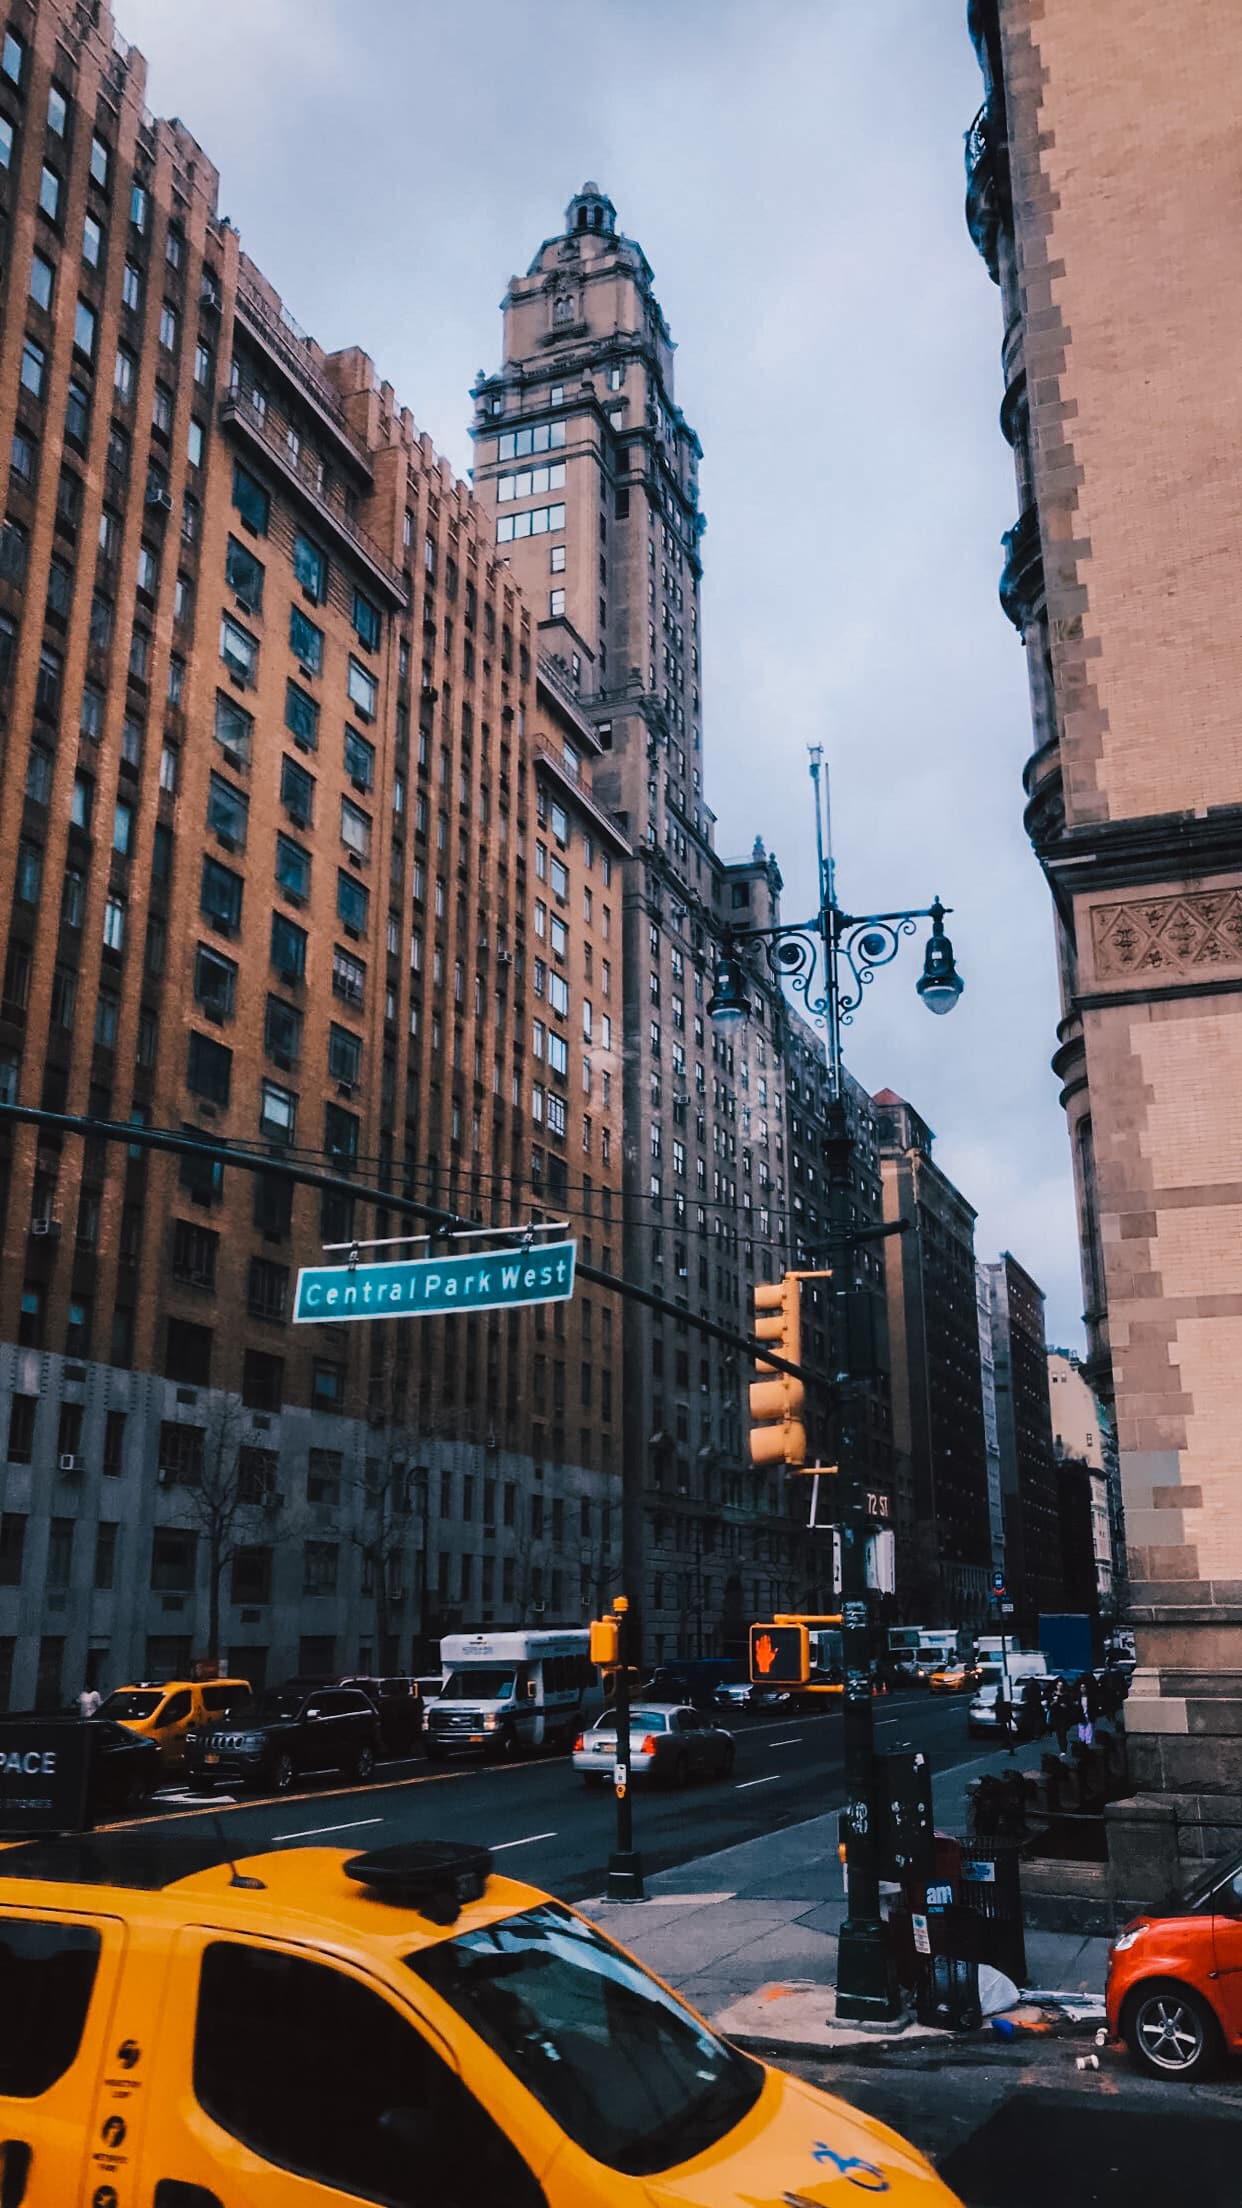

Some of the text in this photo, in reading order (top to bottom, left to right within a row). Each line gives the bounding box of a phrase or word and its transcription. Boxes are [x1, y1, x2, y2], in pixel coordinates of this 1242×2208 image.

[306, 1259, 566, 1306] Central Park West
[867, 1493, 877, 1515] 72
[926, 1885, 953, 1905] am
